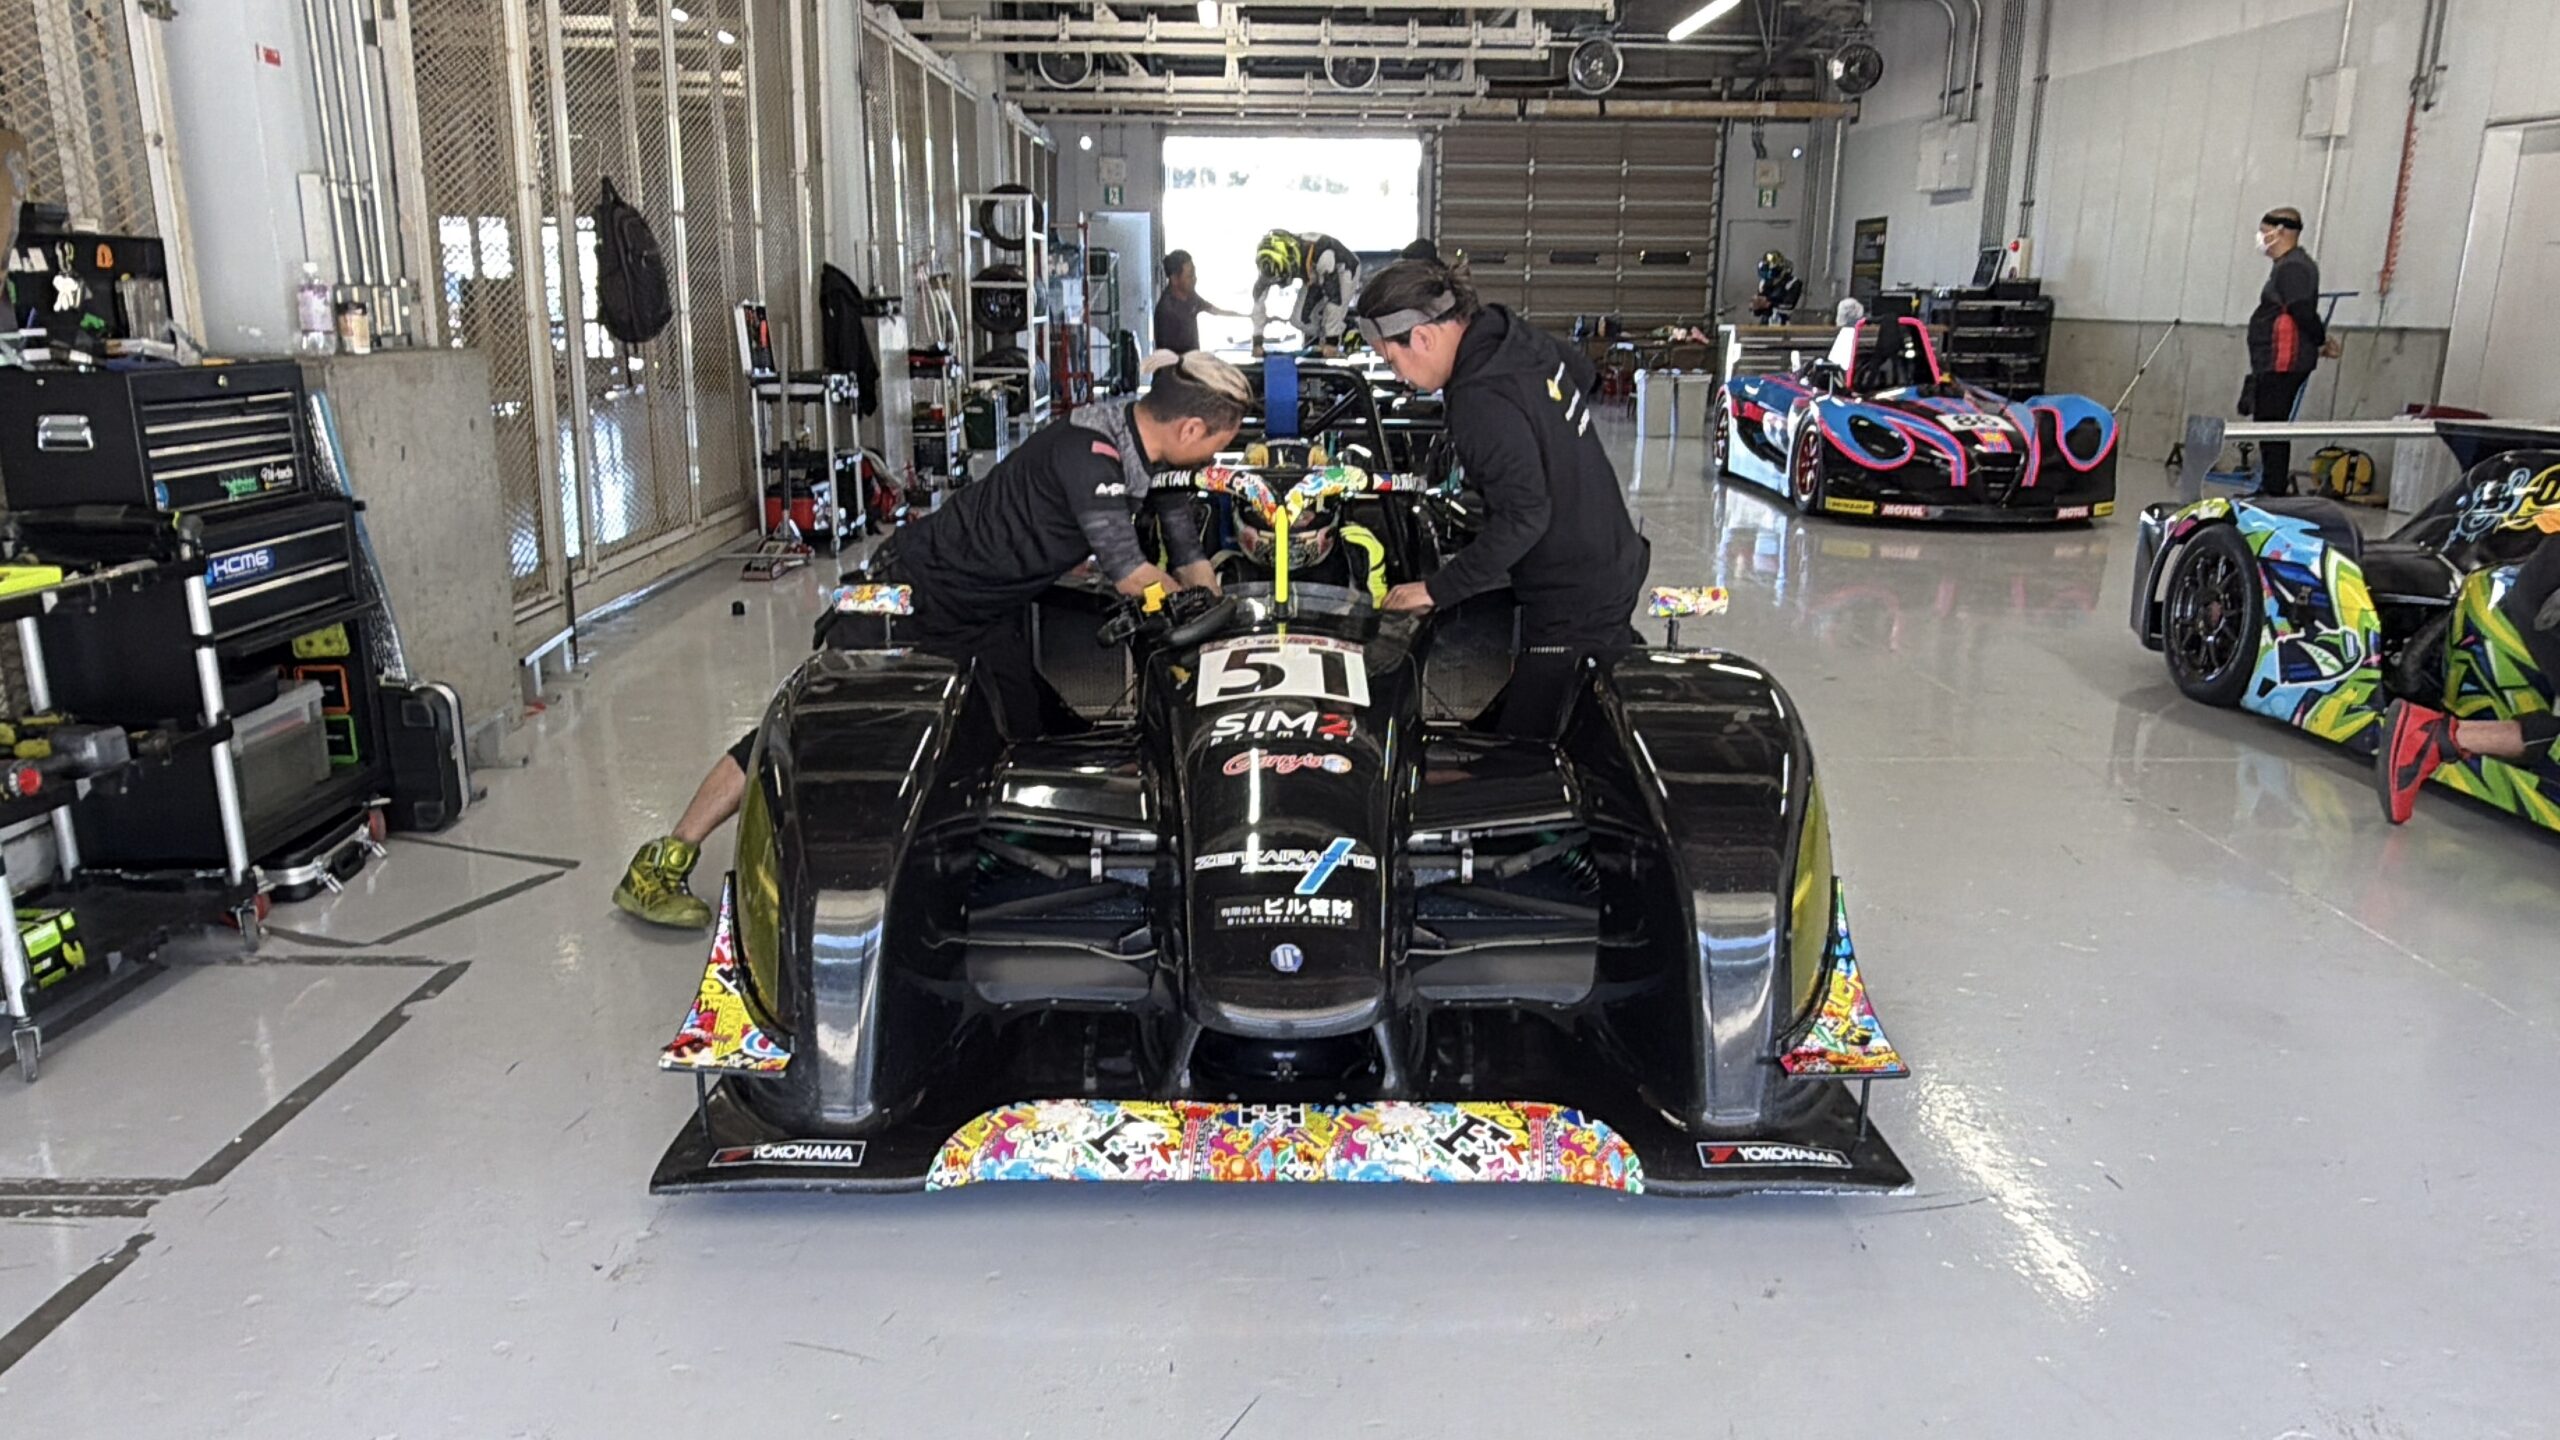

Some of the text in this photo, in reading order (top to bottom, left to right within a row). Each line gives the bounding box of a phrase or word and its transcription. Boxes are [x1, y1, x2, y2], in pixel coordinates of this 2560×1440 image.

[1881, 504, 1924, 517] MOTUL
[1217, 647, 1350, 698] 51
[753, 1144, 854, 1161] YOKOHAMA
[1738, 1146, 1842, 1165] YOKOHAMA
